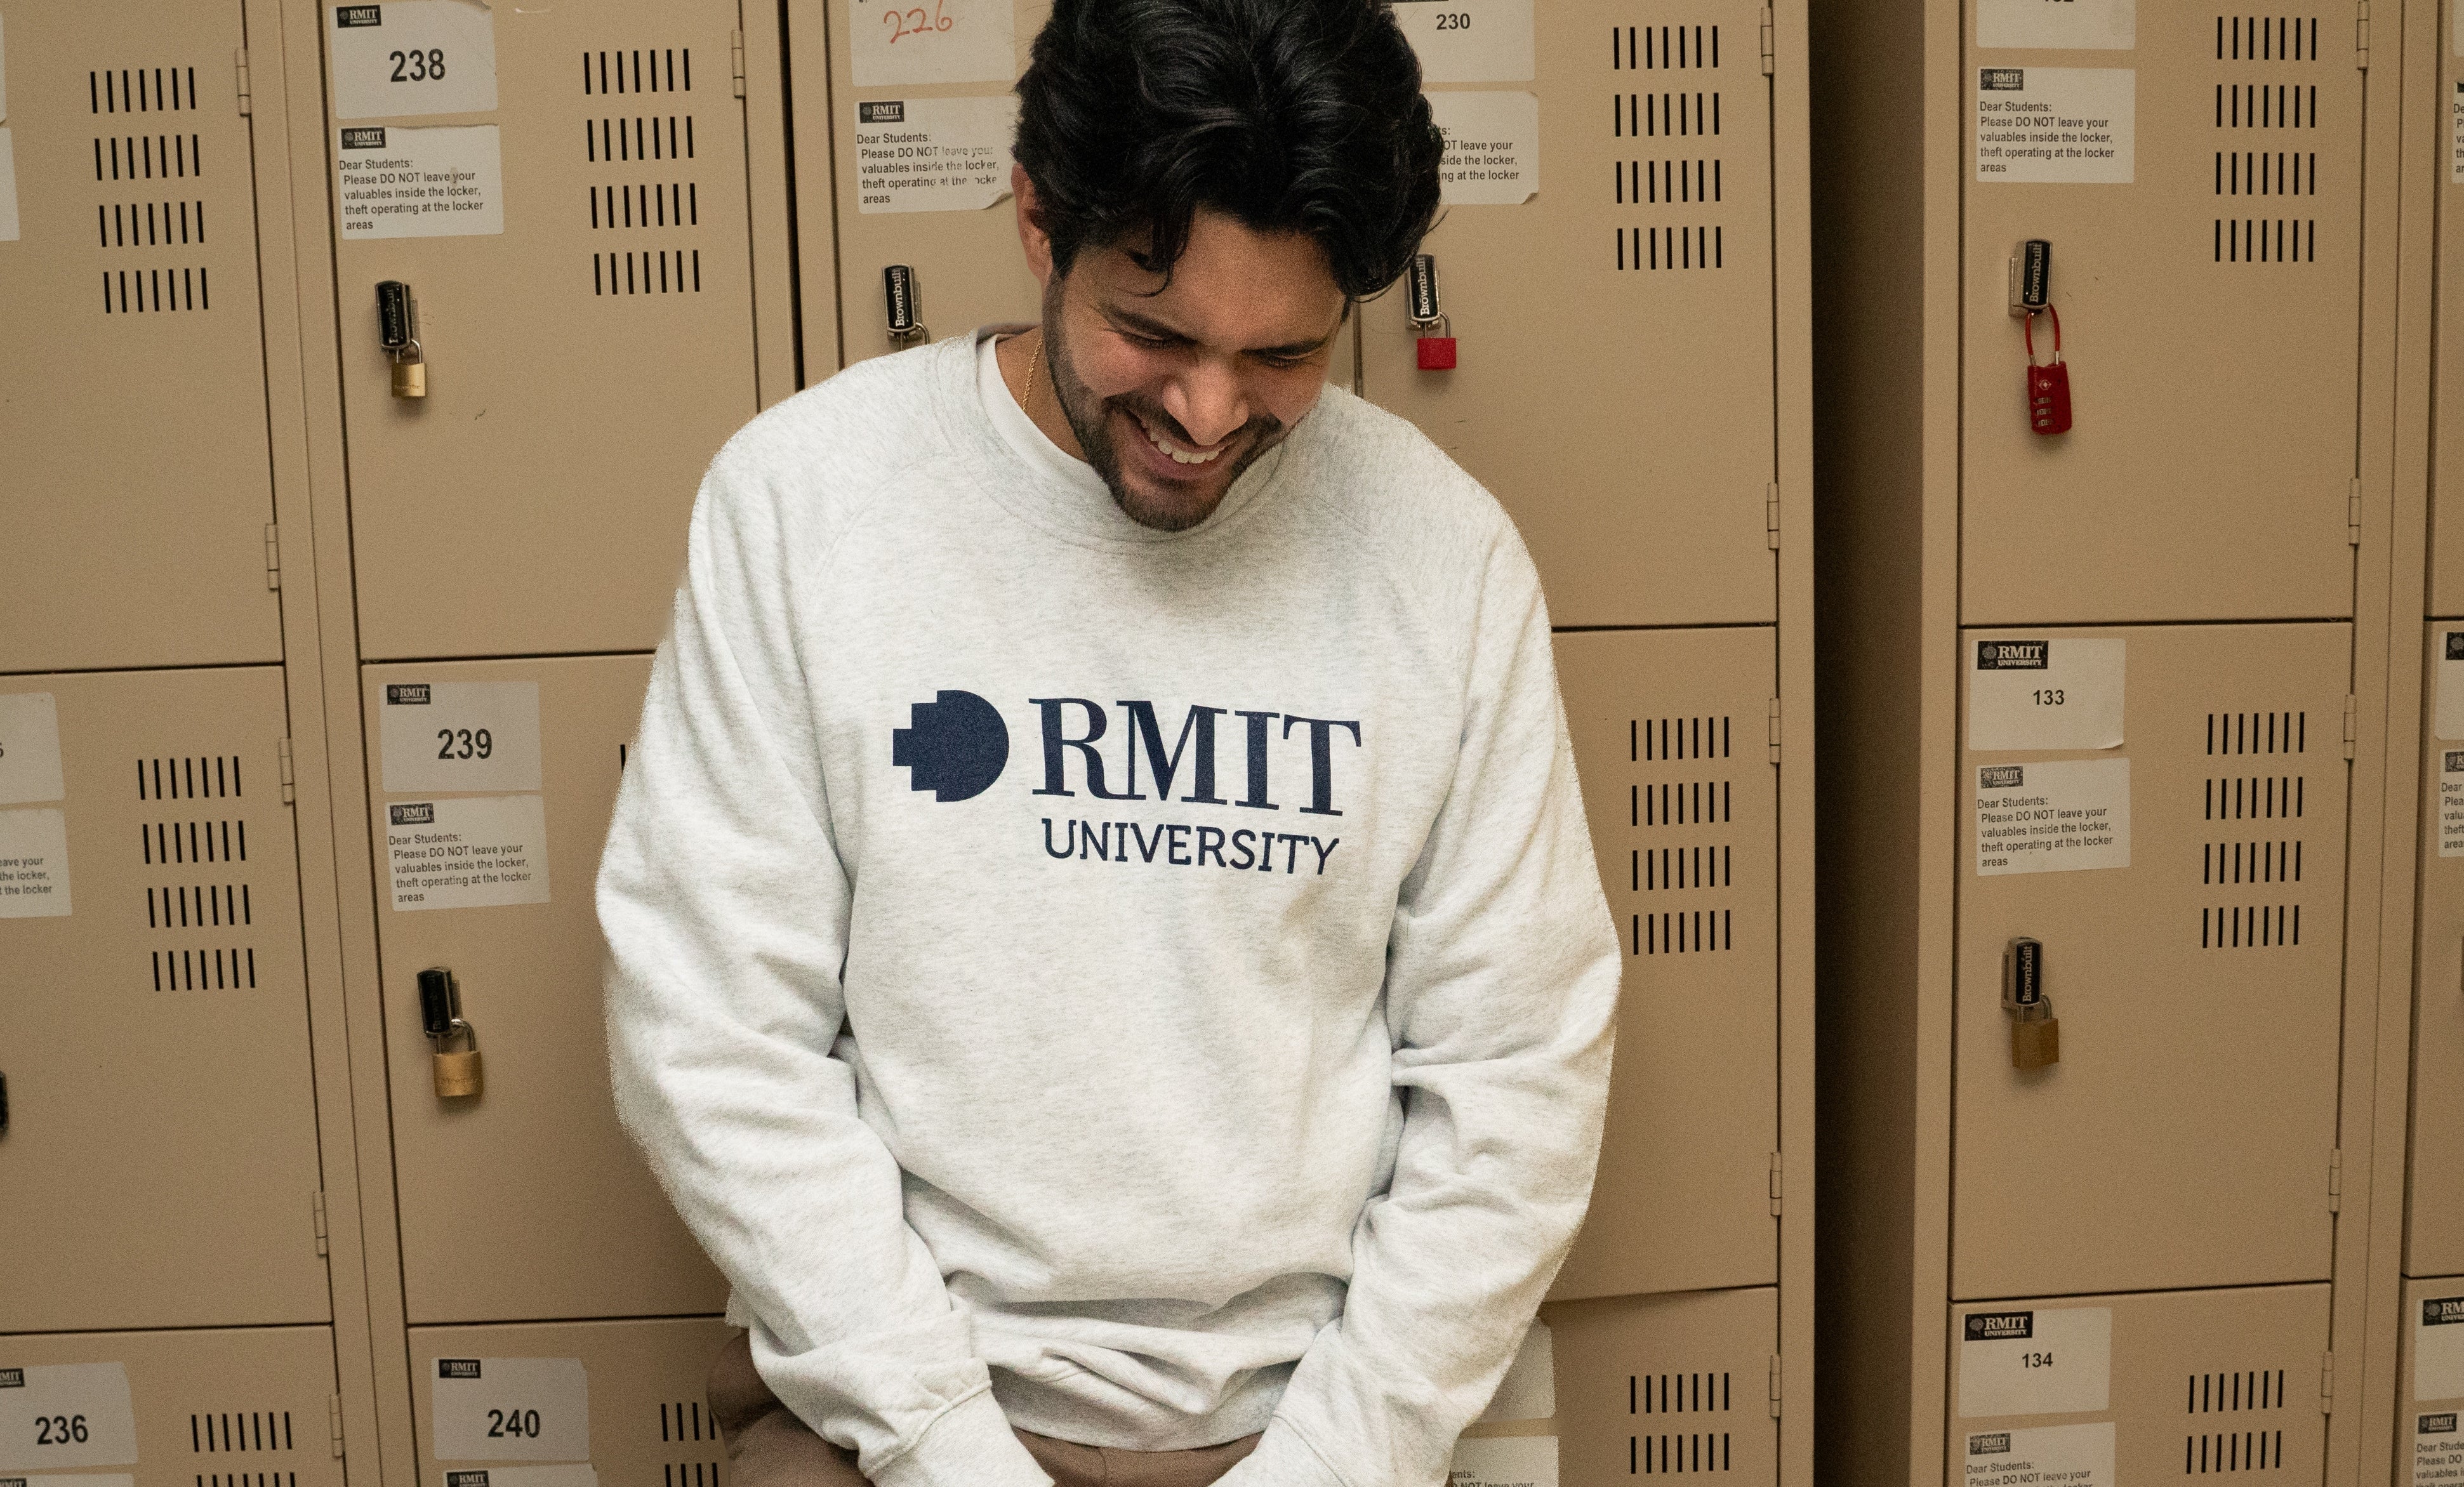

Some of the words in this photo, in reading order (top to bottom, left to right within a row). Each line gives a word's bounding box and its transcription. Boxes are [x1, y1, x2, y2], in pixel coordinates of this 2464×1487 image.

[349, 9, 377, 20] RMIT
[884, 0, 953, 44] 226
[1436, 13, 1471, 30] 230
[389, 49, 446, 82] 238
[1994, 74, 2020, 83] RMIT
[873, 105, 900, 115] RMIT
[1980, 102, 2002, 111] Dear
[2005, 102, 2051, 112] Students:
[1980, 117, 2012, 127] Please
[2016, 117, 2030, 126] DO
[2034, 117, 2055, 127] NOT
[2058, 117, 2083, 127] leave
[2086, 119, 2109, 129] your
[354, 131, 382, 141] RMIT
[857, 134, 880, 144] Dear
[1980, 132, 2026, 142] valuables
[2030, 133, 2059, 142] inside
[2062, 133, 2077, 142] the
[2081, 133, 2112, 143] locker,
[1461, 140, 1487, 150] leave
[1490, 142, 1513, 152] your
[861, 149, 894, 159] Please
[898, 147, 913, 157] DO
[917, 147, 937, 156] NOT
[1980, 147, 2002, 157] theft
[2005, 147, 2051, 160] operating
[2055, 149, 2063, 157] at
[2067, 148, 2081, 157] the
[2084, 148, 2114, 157] locker
[339, 160, 362, 170] Dear
[366, 159, 413, 169] Students:
[1440, 155, 1461, 165] side
[1464, 155, 1480, 165] the
[1483, 155, 1517, 166] locker,
[862, 163, 910, 173] valuables
[946, 161, 962, 170] the
[344, 174, 377, 184] Please
[380, 173, 395, 183] DO
[399, 173, 420, 183] NOT
[424, 173, 450, 182] leave
[453, 172, 475, 184] your
[1457, 171, 1466, 180] at
[1469, 170, 1485, 180] the
[1488, 170, 1519, 180] locker
[863, 178, 885, 189] theft
[952, 176, 967, 185] the
[345, 189, 392, 199] valuables
[395, 188, 425, 198] inside
[428, 187, 444, 197] the
[863, 195, 891, 204] areas
[345, 204, 368, 215] theft
[371, 204, 419, 216] operating
[422, 202, 432, 211] at
[434, 202, 450, 211] the
[453, 201, 483, 211] locker
[347, 221, 373, 230] areas
[2029, 242, 2042, 303] Brownbuilt
[1416, 257, 1429, 316] Brownbuilt
[892, 268, 904, 327] Brownbuilt
[1998, 645, 2043, 659] RMIT
[400, 688, 427, 697] RMIT
[2033, 690, 2064, 705] 133
[437, 729, 492, 760] 239
[1029, 698, 1361, 816] RMIT
[1993, 770, 2020, 780] RMIT
[2442, 783, 2462, 792] Dear
[1977, 799, 1999, 809] Dear
[2003, 796, 2048, 807] Students:
[2445, 797, 2464, 805] Plea
[402, 808, 429, 817] RMIT
[1982, 813, 2013, 823] Please
[2016, 811, 2030, 821] DO
[2034, 810, 2055, 820] NOT
[2058, 809, 2082, 818] leave
[2086, 808, 2107, 820] your
[1982, 827, 2027, 838] valuables
[2030, 825, 2058, 835] inside
[2062, 824, 2076, 833] the
[389, 836, 411, 845] Dear
[414, 833, 461, 843] Students:
[1982, 842, 2003, 852] theft
[2006, 840, 2051, 852] operating
[2055, 839, 2063, 848] at
[2066, 838, 2081, 847] the
[2084, 836, 2113, 846] locker
[394, 850, 427, 859] Please
[430, 847, 444, 857] DO
[447, 846, 468, 856] NOT
[472, 845, 498, 854] leave
[501, 845, 523, 857] your
[1042, 818, 1339, 875] UNIVERSITY
[22, 858, 44, 868] your
[395, 862, 442, 873] valuables
[445, 861, 474, 871] inside
[477, 860, 493, 869] the
[1982, 857, 2008, 866] areas
[396, 878, 418, 888] theft
[421, 876, 468, 889] operating
[472, 875, 480, 883] at
[483, 874, 498, 883] the
[501, 872, 531, 882] locker
[4, 886, 20, 895] the
[23, 884, 51, 894] locker
[399, 892, 424, 902] areas
[2022, 946, 2032, 1003] Brownbuilt
[1985, 1317, 2028, 1330] RMIT
[2022, 1352, 2053, 1368] 134
[451, 1363, 476, 1371] RMIT
[488, 1409, 540, 1437] 240
[35, 1415, 88, 1444] 236
[2417, 1444, 2436, 1453] Dear
[2417, 1457, 2445, 1466] Please
[2449, 1455, 2461, 1464] DO
[1966, 1465, 1987, 1474] Dear
[1990, 1461, 2034, 1472] Students:
[460, 1474, 484, 1483] RMIT
[1970, 1478, 2000, 1487] Please
[2003, 1475, 2017, 1484] DO
[2020, 1473, 2040, 1483] NOT
[2070, 1470, 2091, 1481] your
[2416, 1469, 2458, 1479] valuables
